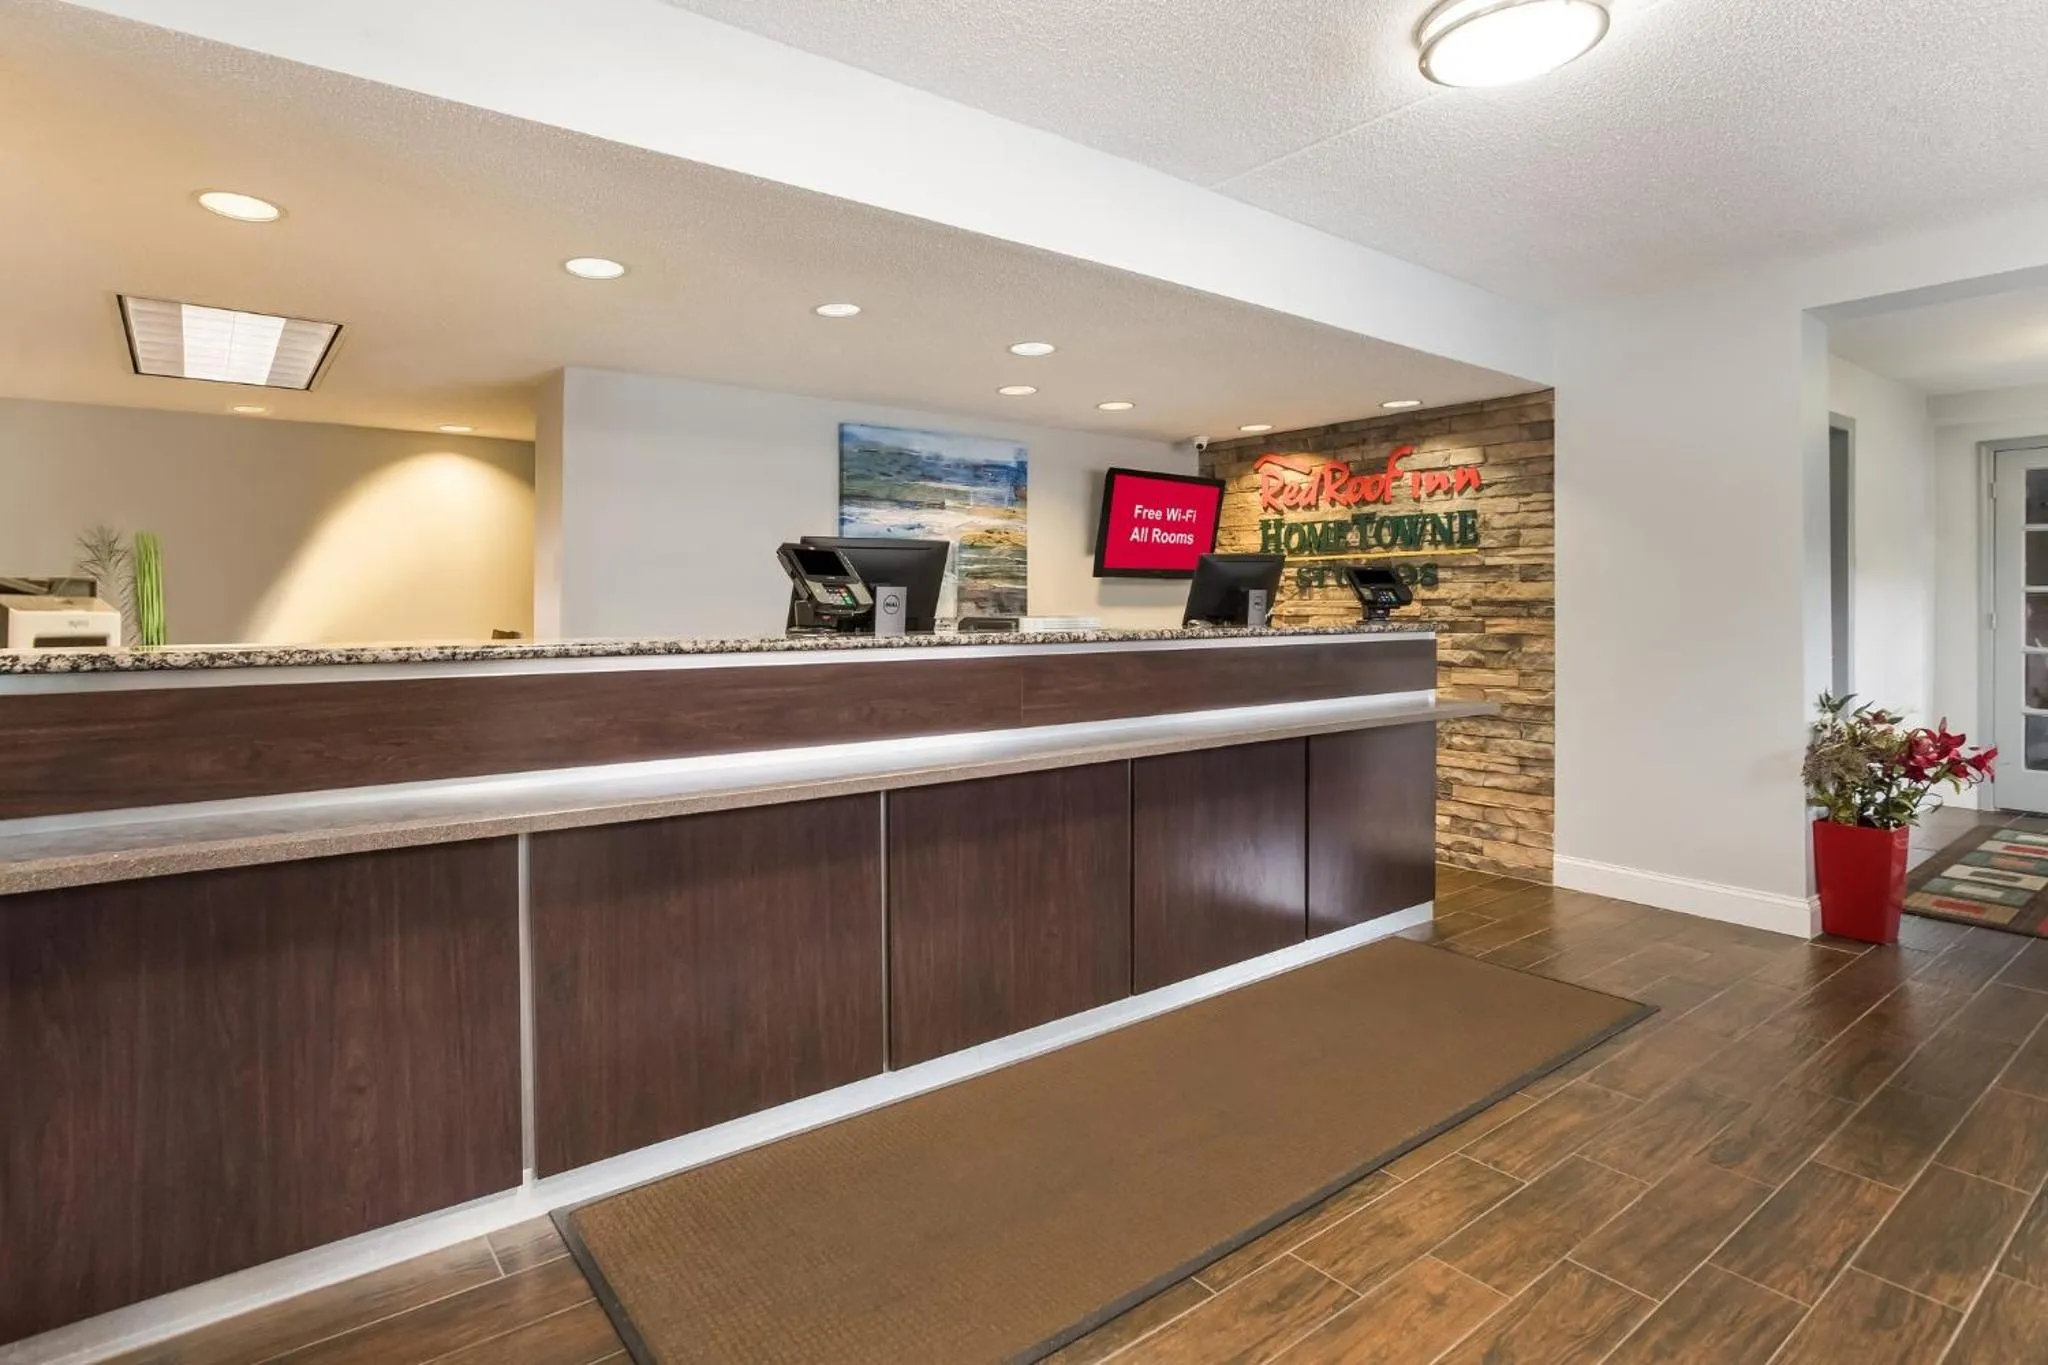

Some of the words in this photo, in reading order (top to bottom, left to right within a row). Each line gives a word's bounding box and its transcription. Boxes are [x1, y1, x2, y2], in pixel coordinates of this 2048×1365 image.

[1260, 470, 1325, 511] Red
[1324, 446, 1415, 506] Roof
[1133, 504, 1163, 520] Free
[1166, 507, 1197, 523] Wi-Fi
[1129, 526, 1149, 542] All
[1151, 527, 1194, 545] Rooms
